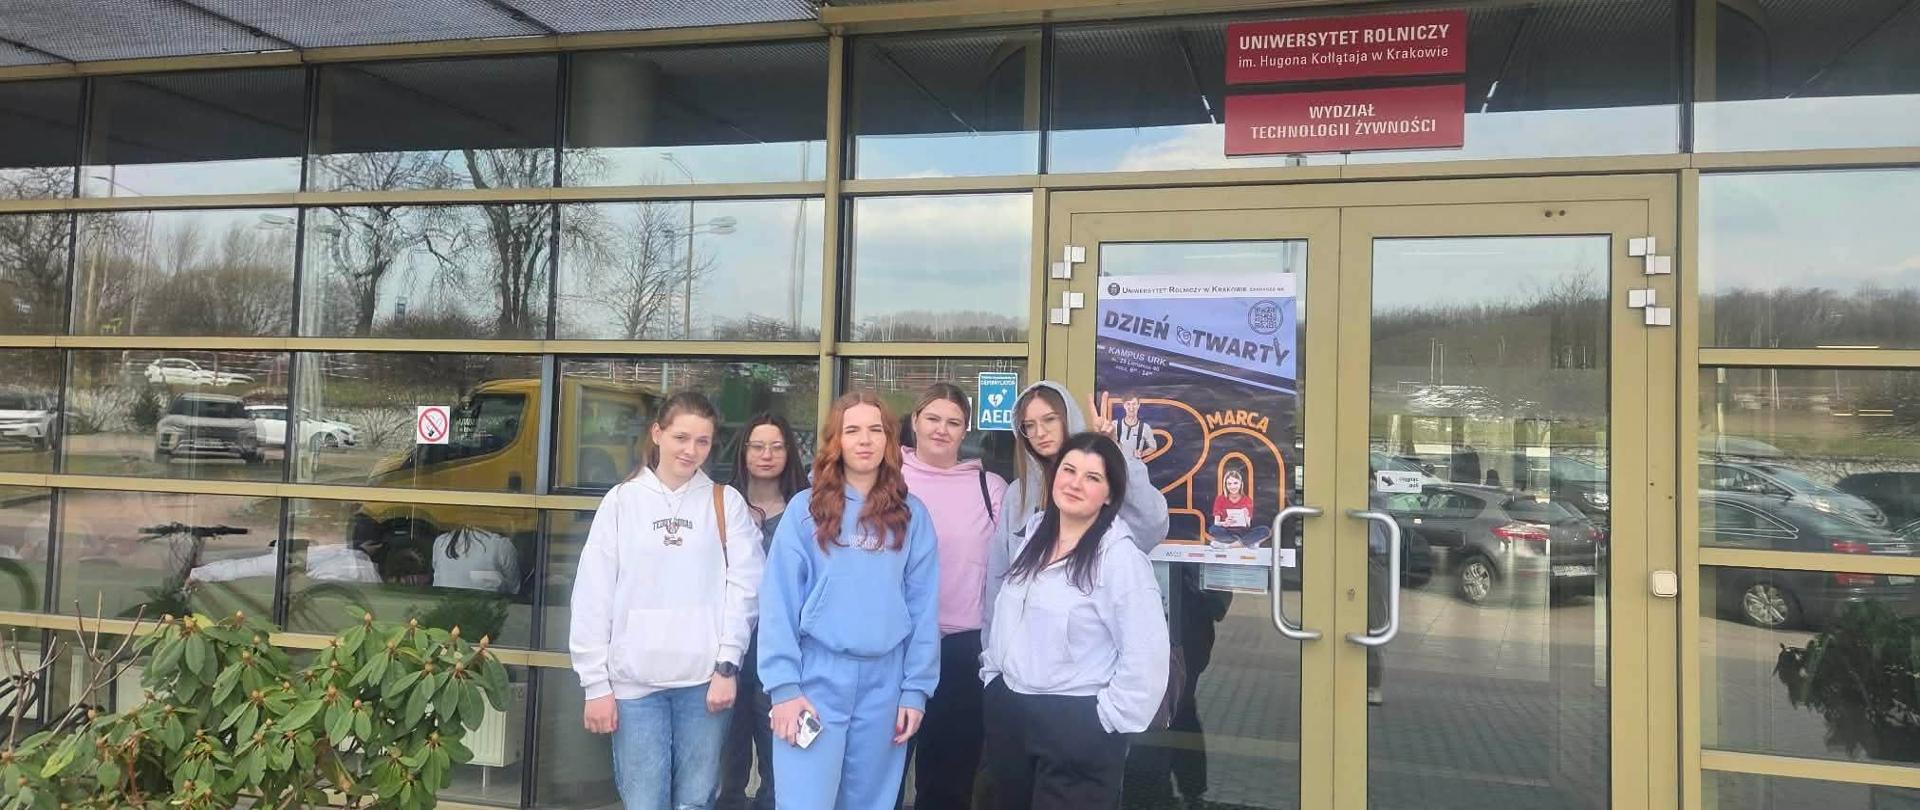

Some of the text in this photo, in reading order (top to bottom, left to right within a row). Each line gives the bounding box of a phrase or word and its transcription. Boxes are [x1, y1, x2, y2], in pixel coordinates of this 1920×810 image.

[1239, 23, 1450, 50] UNIWERSYTET ROLNICZY
[1238, 46, 1449, 69] im. Hugona Kołłątaja w Krakowie
[1309, 103, 1376, 119] WYDZIAŁ
[1250, 116, 1436, 139] TECHNOLOGII ŻYWNOŚCI
[1104, 310, 1170, 341] DZIEŃ
[1108, 346, 1145, 361] KAMPUS
[1147, 355, 1167, 366] URK
[980, 409, 1013, 424] AED
[1205, 409, 1269, 433] MARCA
